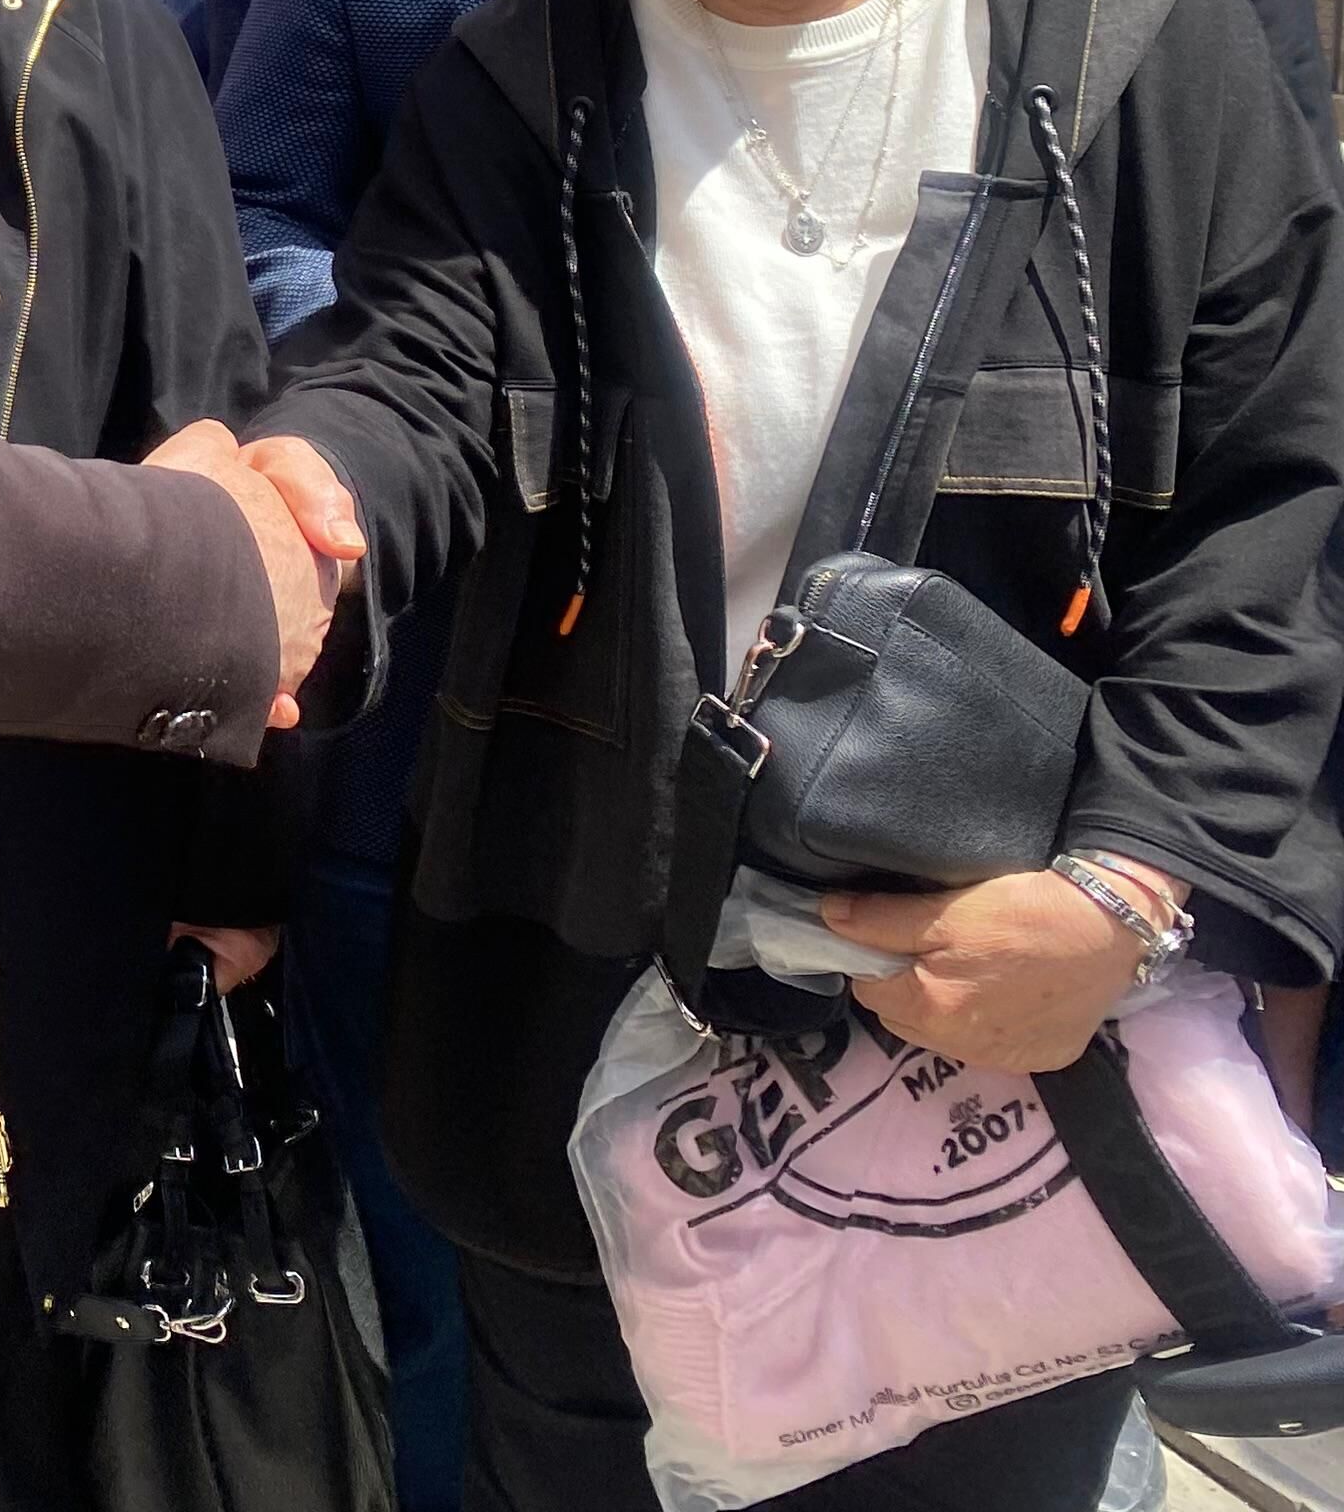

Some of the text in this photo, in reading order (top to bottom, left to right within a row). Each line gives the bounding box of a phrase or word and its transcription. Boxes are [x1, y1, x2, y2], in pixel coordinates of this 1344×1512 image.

[901, 1055, 965, 1102] MA
[941, 1099, 1025, 1169] 2007
[778, 1419, 846, 1449] Sümer
